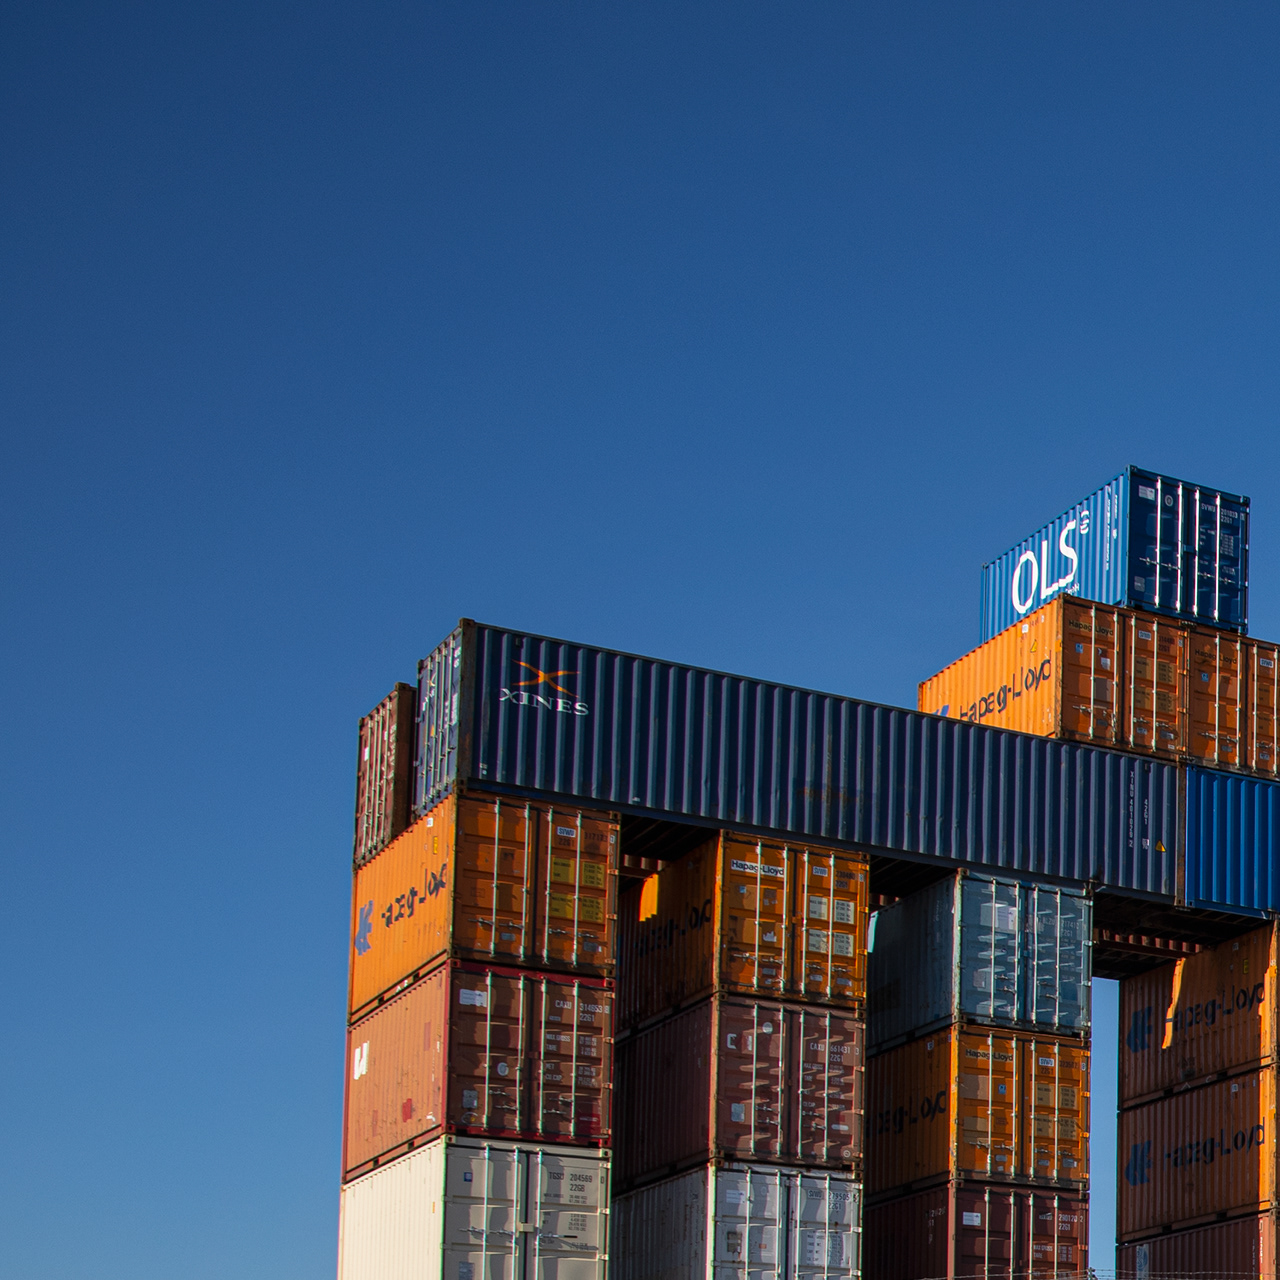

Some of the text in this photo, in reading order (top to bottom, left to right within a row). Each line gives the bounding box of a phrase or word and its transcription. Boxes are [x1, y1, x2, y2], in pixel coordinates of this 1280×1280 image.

[1012, 519, 1078, 614] OLS
[499, 687, 590, 716] XINES
[555, 1000, 572, 1010] CAXU
[809, 1042, 825, 1051] CAXU
